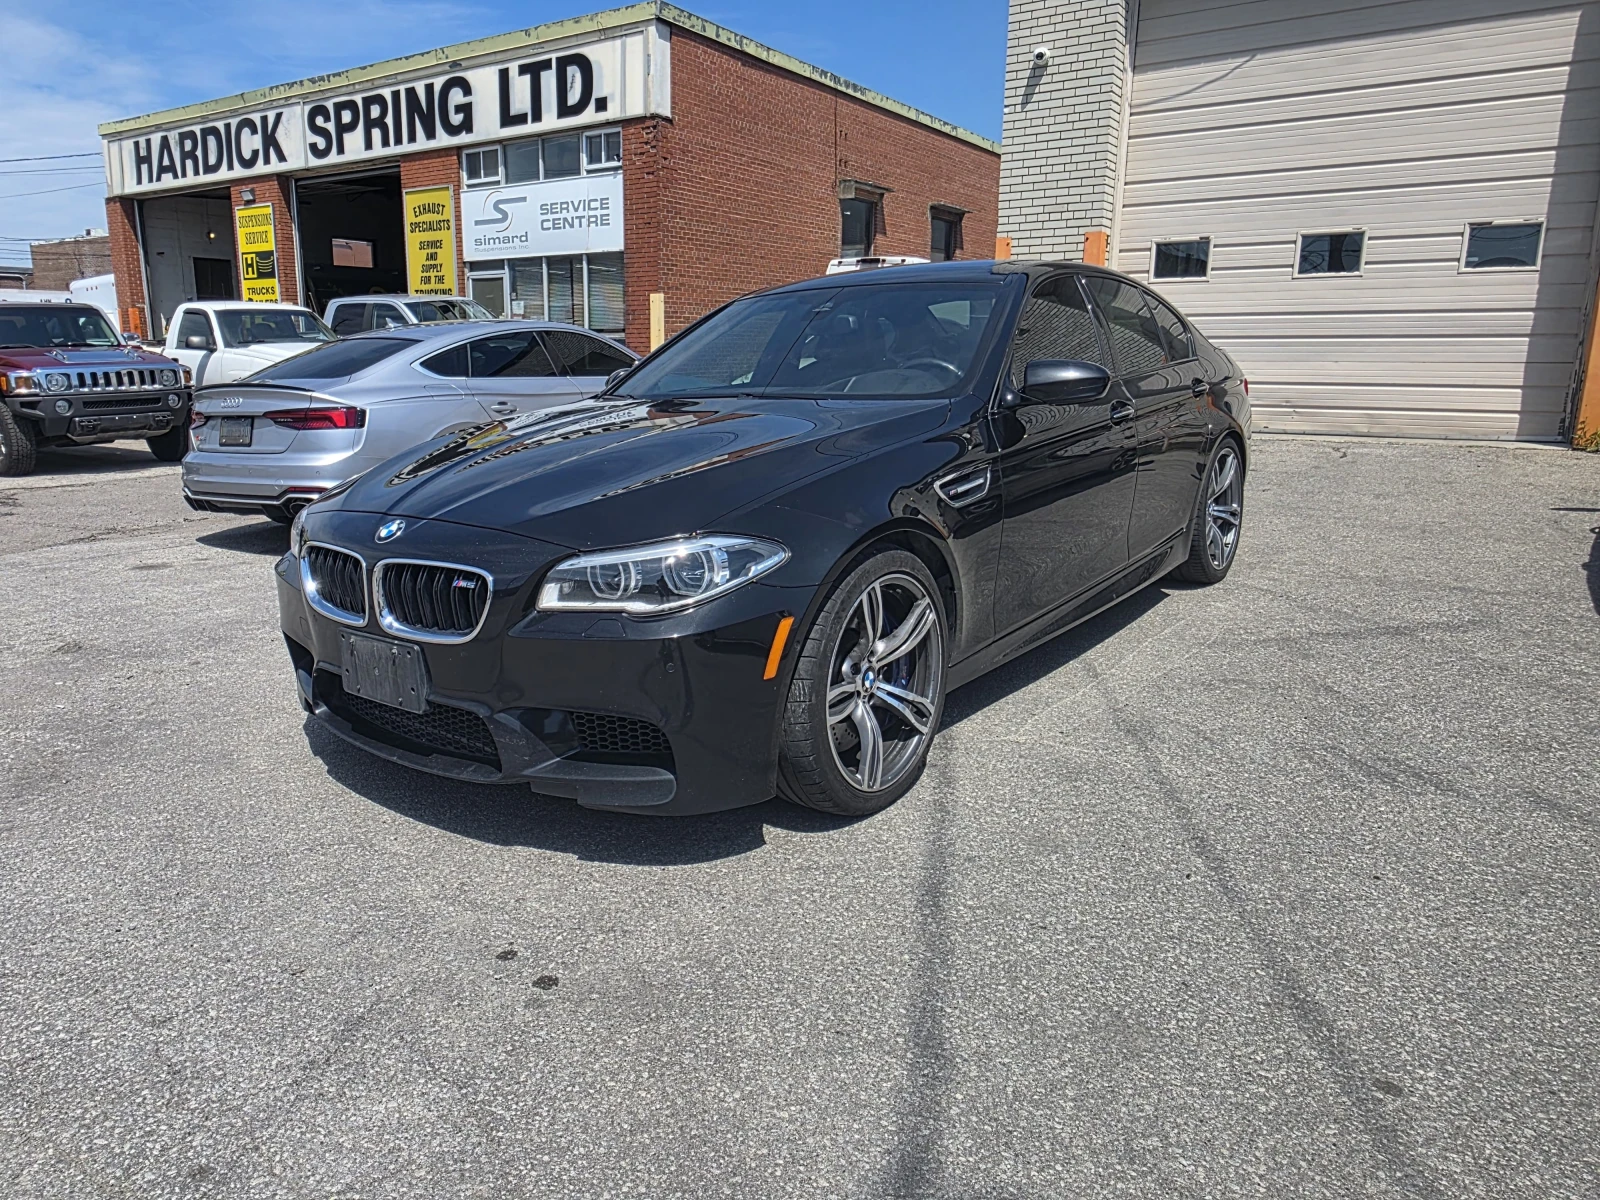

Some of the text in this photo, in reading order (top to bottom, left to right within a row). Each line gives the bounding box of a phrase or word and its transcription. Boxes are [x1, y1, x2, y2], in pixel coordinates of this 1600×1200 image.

[133, 53, 607, 185] HARDICK SPRING LTD.
[412, 202, 446, 218] EXHAUST
[539, 197, 610, 216] SERVICE
[238, 213, 272, 229] SUSPENSIONS
[409, 219, 451, 233] SPECIALISTS
[540, 213, 611, 231] CENTRE
[245, 230, 269, 245] SERVICE
[418, 239, 444, 251] SERVICE
[474, 231, 529, 247] simard
[425, 252, 438, 262] AND
[244, 256, 255, 276] H
[421, 263, 443, 274] SUPPLY
[420, 274, 445, 285] FOR THE
[247, 286, 275, 296] TRUCKS
